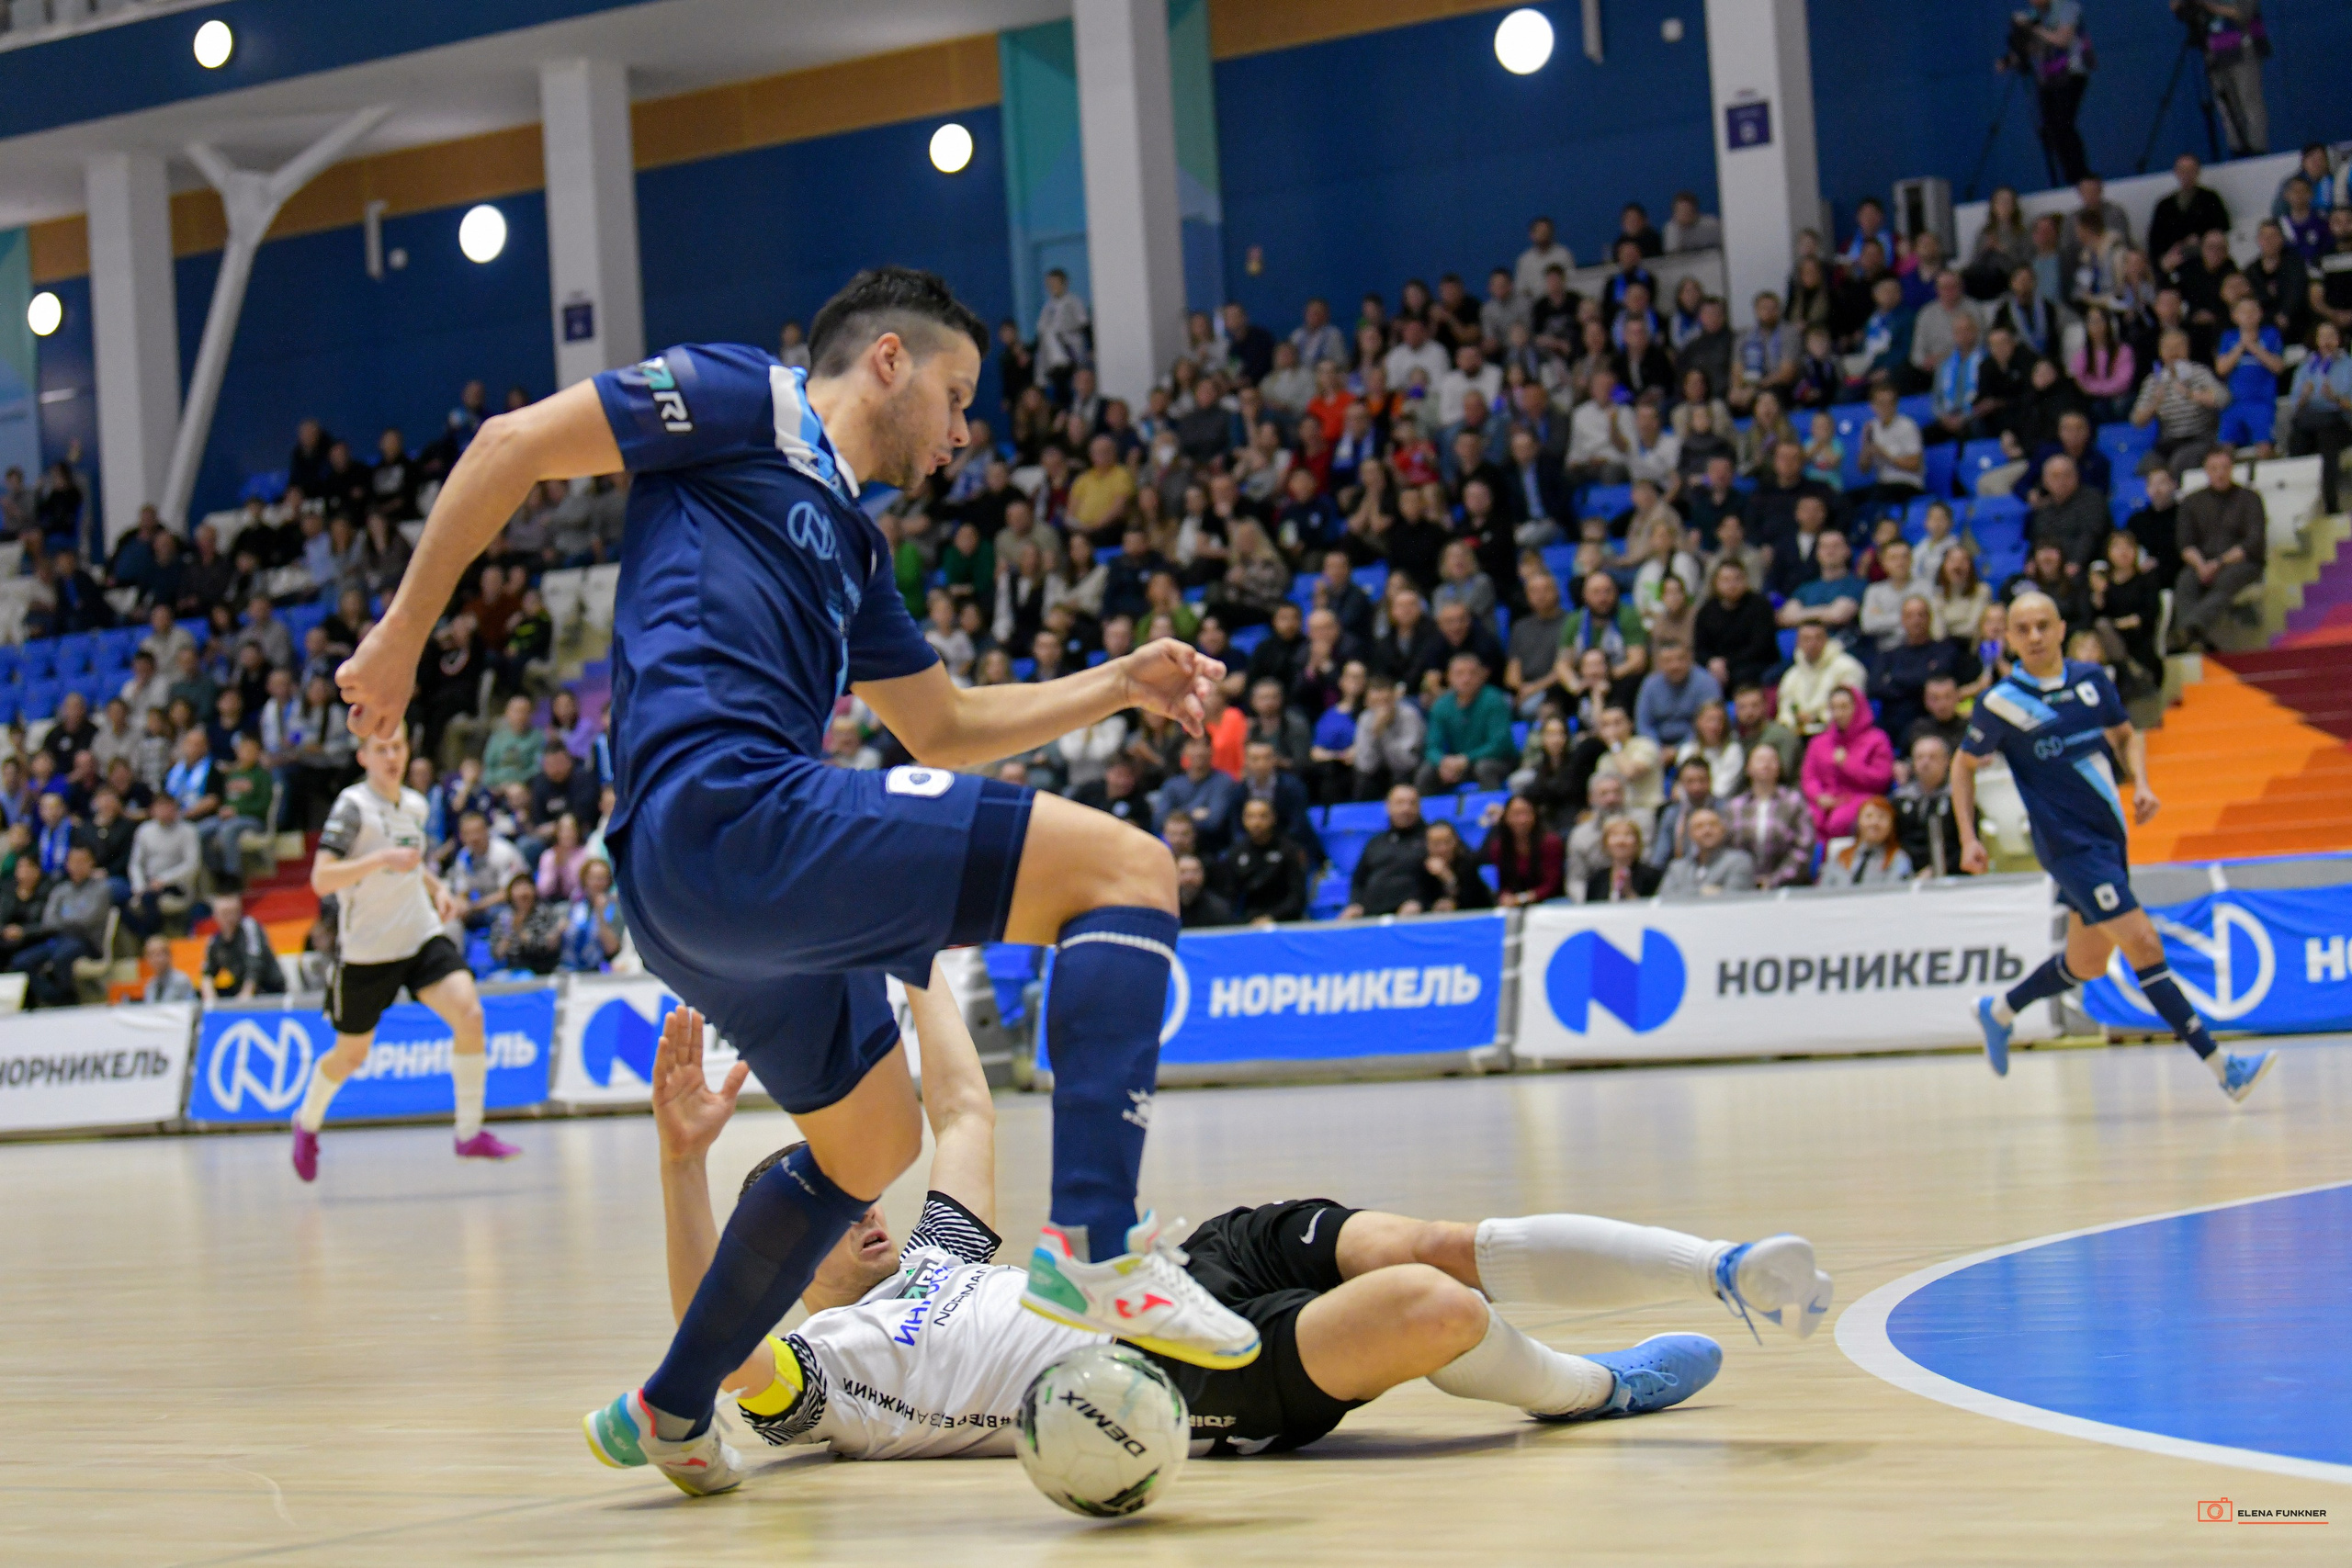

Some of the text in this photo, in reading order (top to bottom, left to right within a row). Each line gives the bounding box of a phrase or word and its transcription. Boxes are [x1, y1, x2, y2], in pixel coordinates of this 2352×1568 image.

[1210, 964, 1481, 1018] НОРНИКЕЛЬ
[1718, 946, 2023, 997] НОРНИКЕЛЬ
[1058, 1390, 1148, 1458] DEMIX
